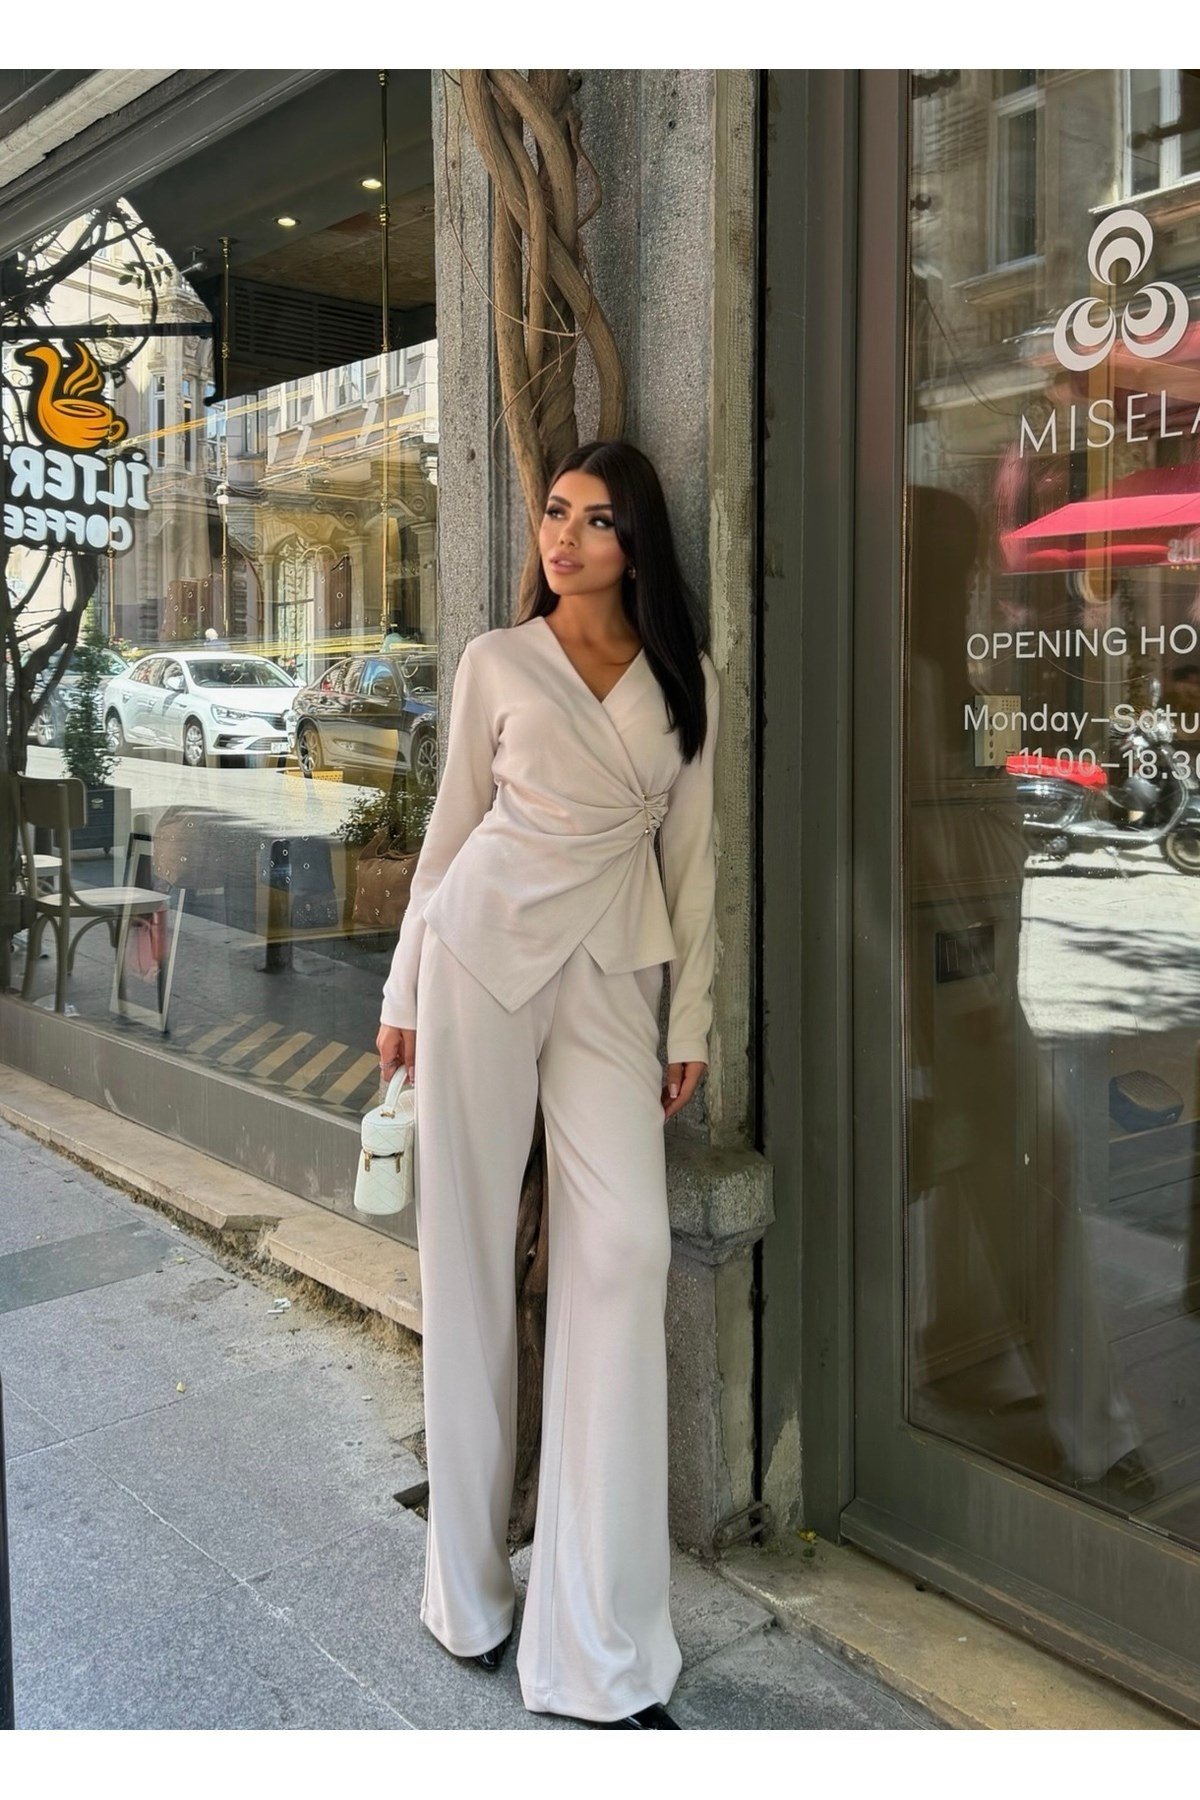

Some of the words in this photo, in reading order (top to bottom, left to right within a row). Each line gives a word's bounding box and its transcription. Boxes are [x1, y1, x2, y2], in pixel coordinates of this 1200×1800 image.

[1019, 389, 1200, 459] MISEL
[966, 626, 1128, 660] OPENING
[1140, 623, 1198, 655] HO
[1018, 746, 1200, 780] 11.00–18.3
